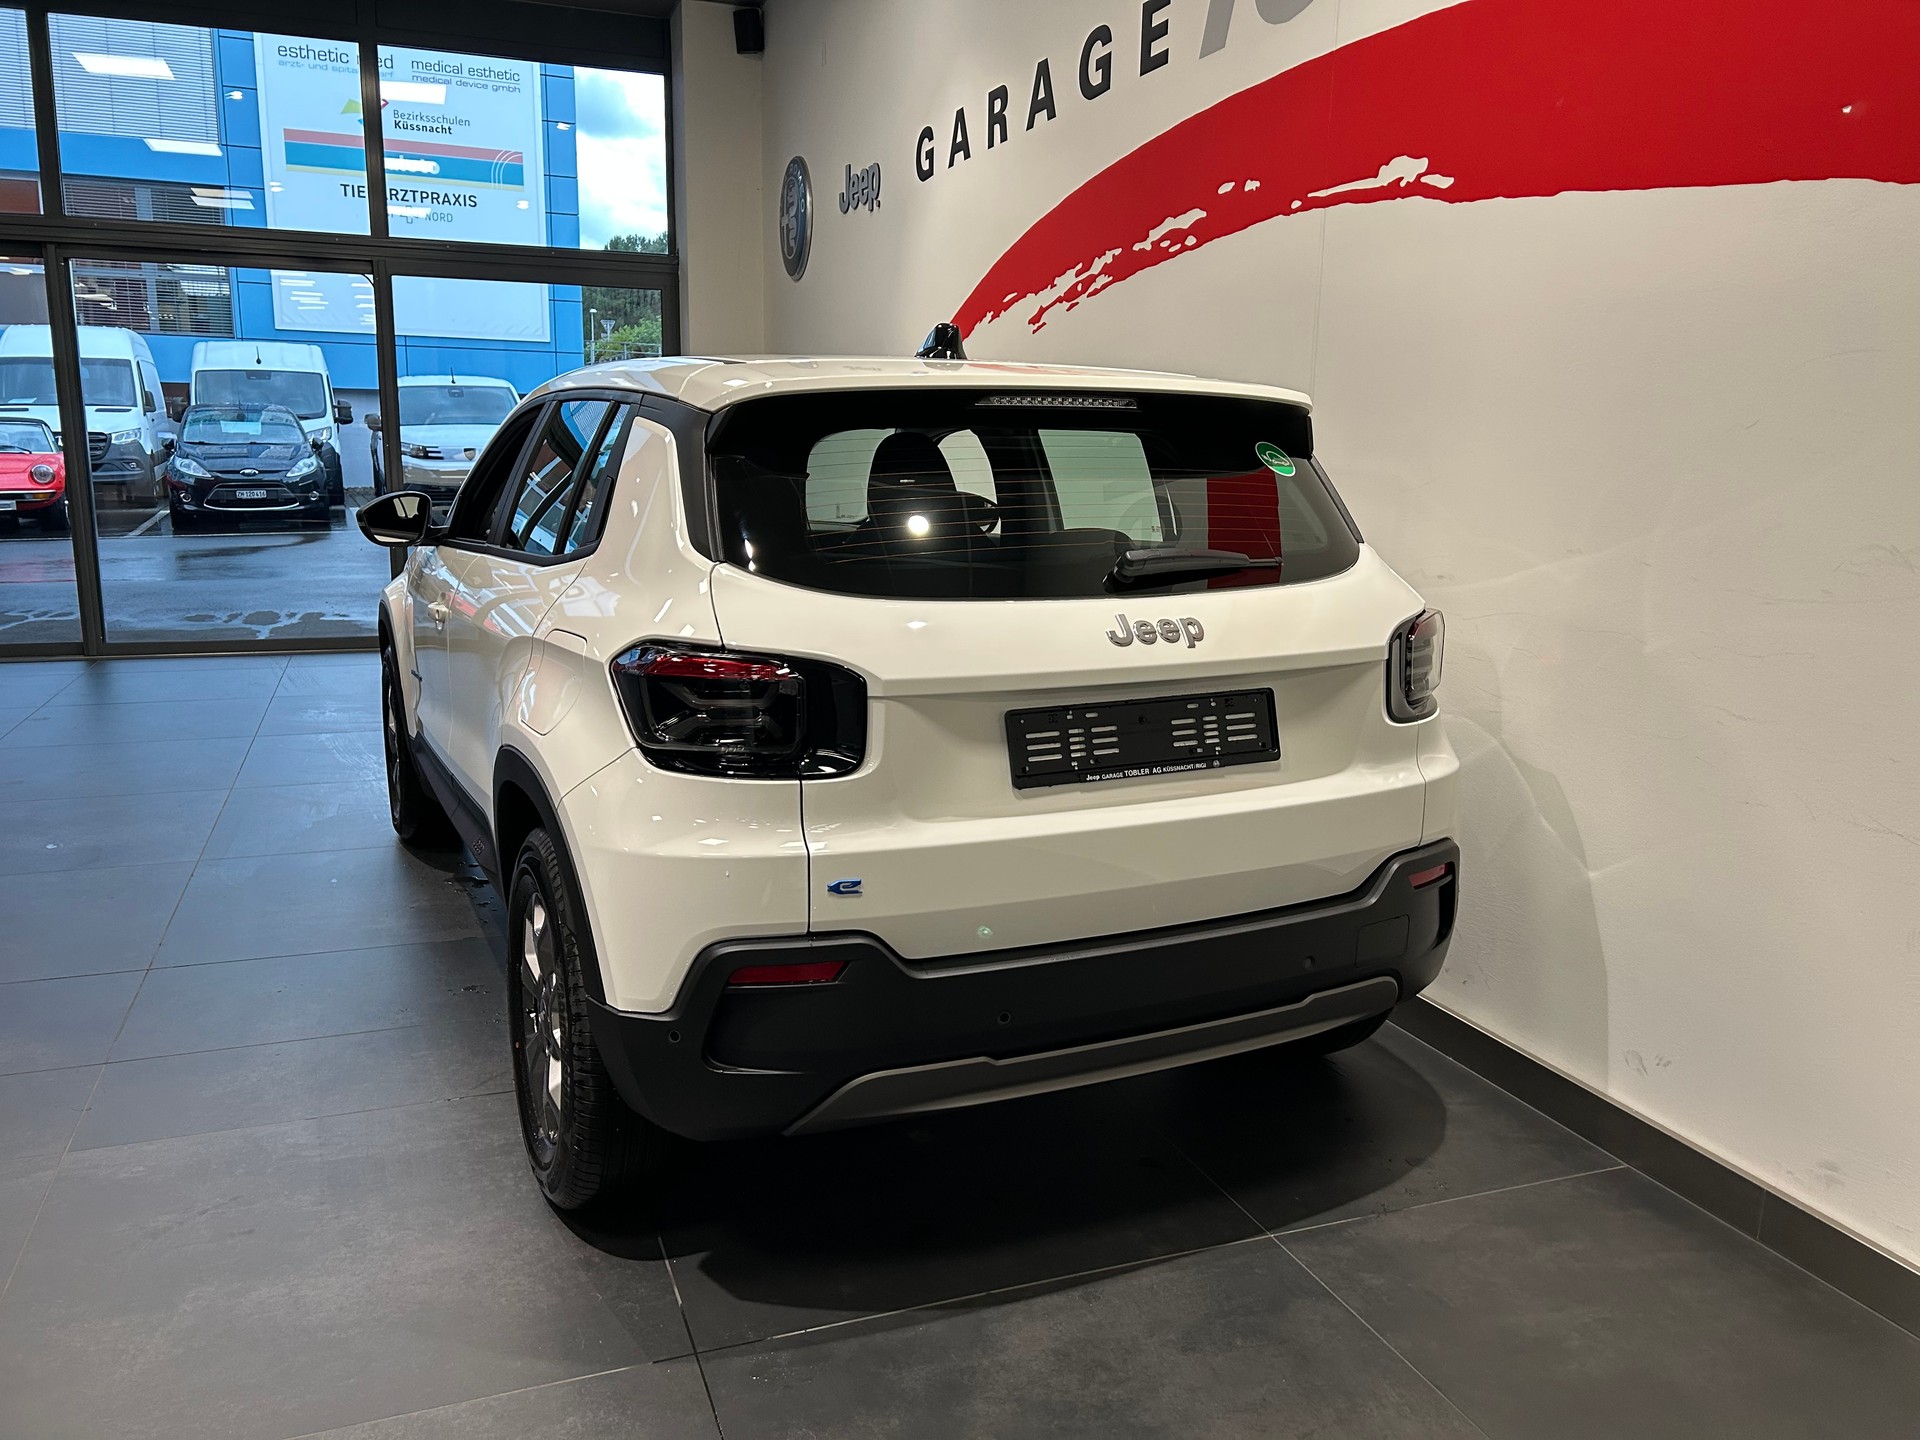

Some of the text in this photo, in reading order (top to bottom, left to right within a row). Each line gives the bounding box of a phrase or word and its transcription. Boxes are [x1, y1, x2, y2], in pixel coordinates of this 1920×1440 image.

[277, 44, 350, 64] esthetic
[307, 63, 328, 71] und
[411, 60, 521, 82] medical esthetic
[411, 74, 521, 93] medical device gmbh
[915, 0, 1170, 182] GARAGE
[393, 109, 471, 126] Bezirksschulen
[394, 120, 453, 135] Küssnacht
[340, 183, 478, 208] TIERZTPRAXIS
[425, 210, 453, 223] NORD
[1106, 613, 1205, 649] Jeep
[1101, 772, 1124, 780] GARAGE
[1124, 768, 1150, 777] TOBLER
[1152, 766, 1162, 774] AG
